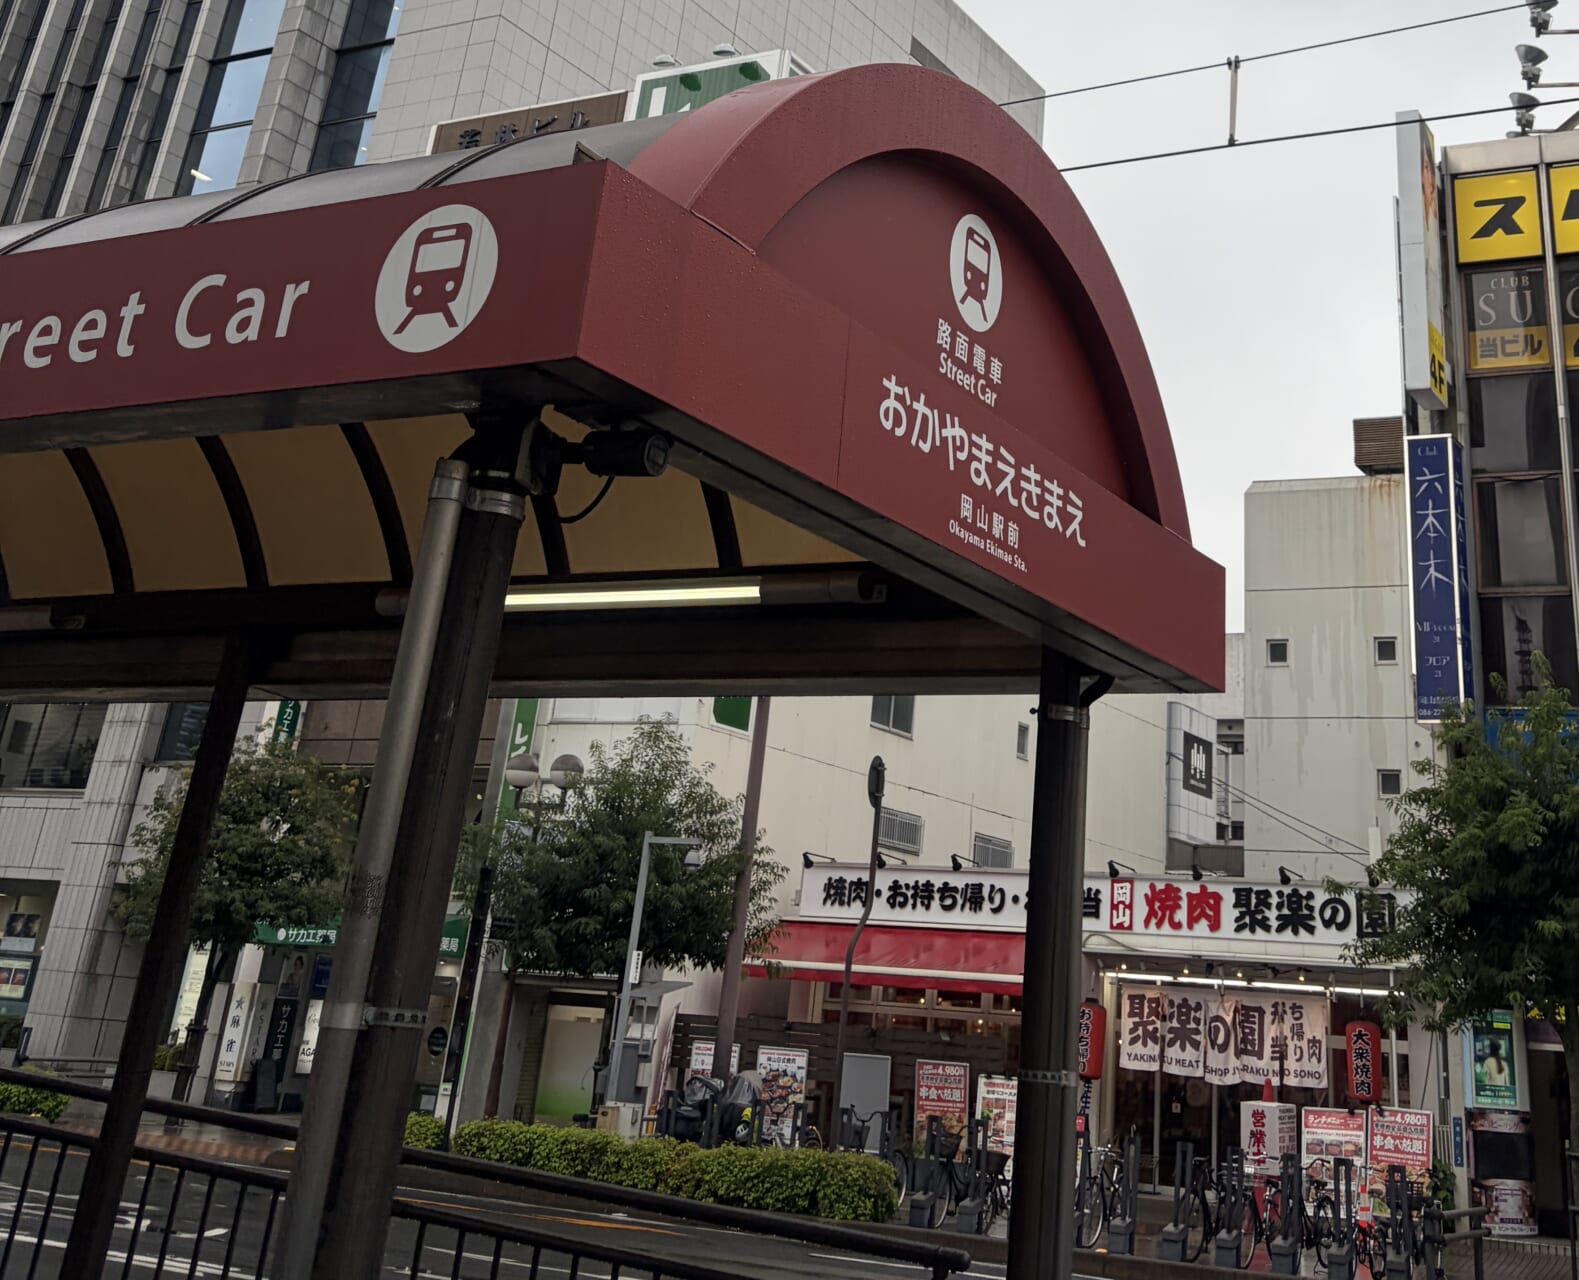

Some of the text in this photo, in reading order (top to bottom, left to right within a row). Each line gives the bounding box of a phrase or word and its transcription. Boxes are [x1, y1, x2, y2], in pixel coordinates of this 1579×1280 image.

[1490, 276, 1530, 289] CLUB
[174, 273, 310, 350] Car
[937, 318, 1003, 385] 路面電車
[1430, 354, 1445, 394] 4F
[939, 352, 998, 408] Street Car
[879, 374, 1087, 547] おかやまえきまえ
[949, 519, 1028, 573] Okayama Ekimae Sta.
[960, 493, 1020, 549] 岡山駅前
[1415, 467, 1454, 593] 六本木
[1112, 881, 1131, 928] 岡山
[1143, 882, 1223, 933] 焼肉
[226, 1014, 241, 1053] 麻雀
[1127, 994, 1265, 1060] 聚楽の園
[1174, 1058, 1200, 1070] MEAT
[1206, 1064, 1230, 1077] SHOP
[1293, 1069, 1321, 1081] SONO
[1352, 1028, 1372, 1096] 大衆焼肉
